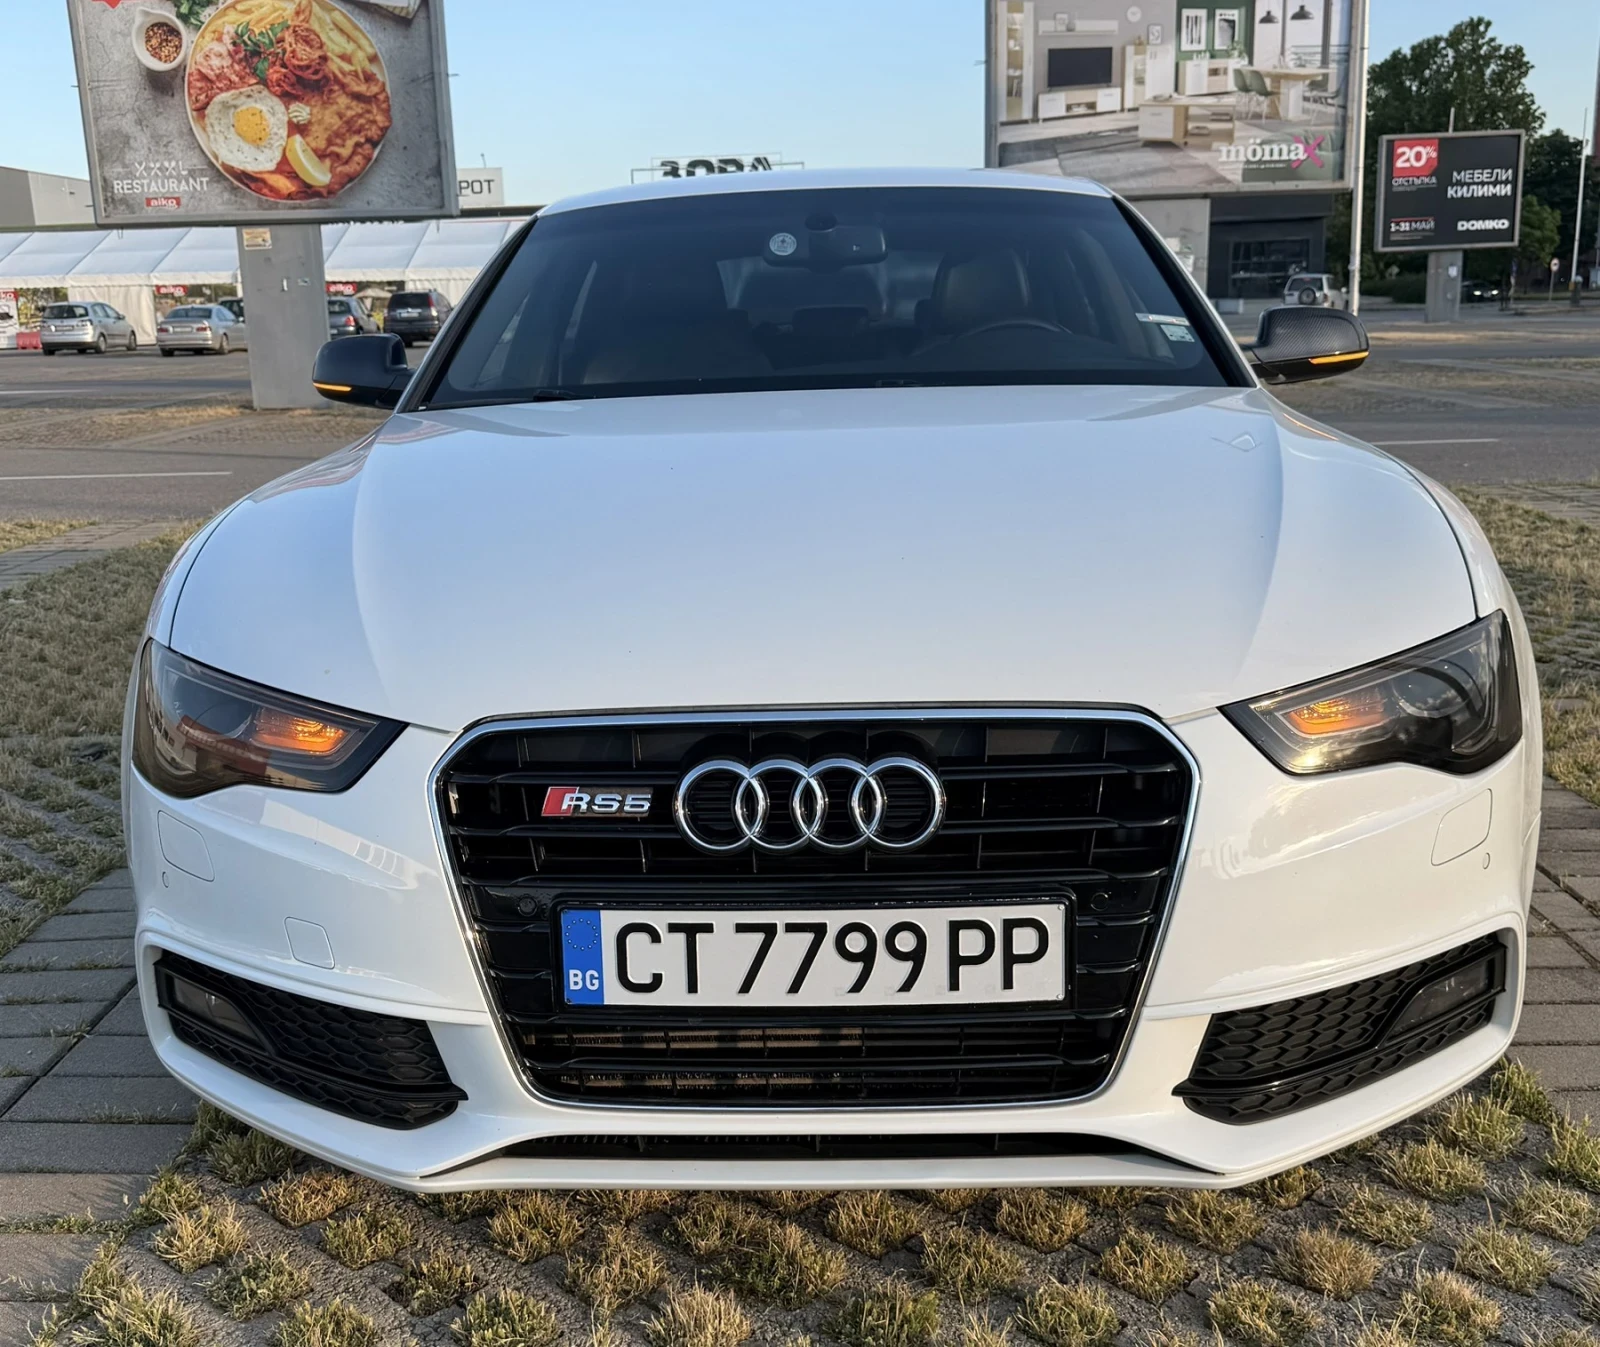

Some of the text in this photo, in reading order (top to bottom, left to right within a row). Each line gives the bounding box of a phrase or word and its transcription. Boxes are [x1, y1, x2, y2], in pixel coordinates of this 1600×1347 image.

[1395, 145, 1438, 168] 20%
[1452, 168, 1513, 183] МЕБЕЛИ
[113, 177, 209, 194] RESTAURANT
[1447, 184, 1512, 199] КИЛИМИ
[1457, 219, 1510, 231] DOMKO
[560, 792, 652, 814] RS5
[615, 917, 1050, 994] CT 7799 PP
[568, 969, 600, 991] BG
